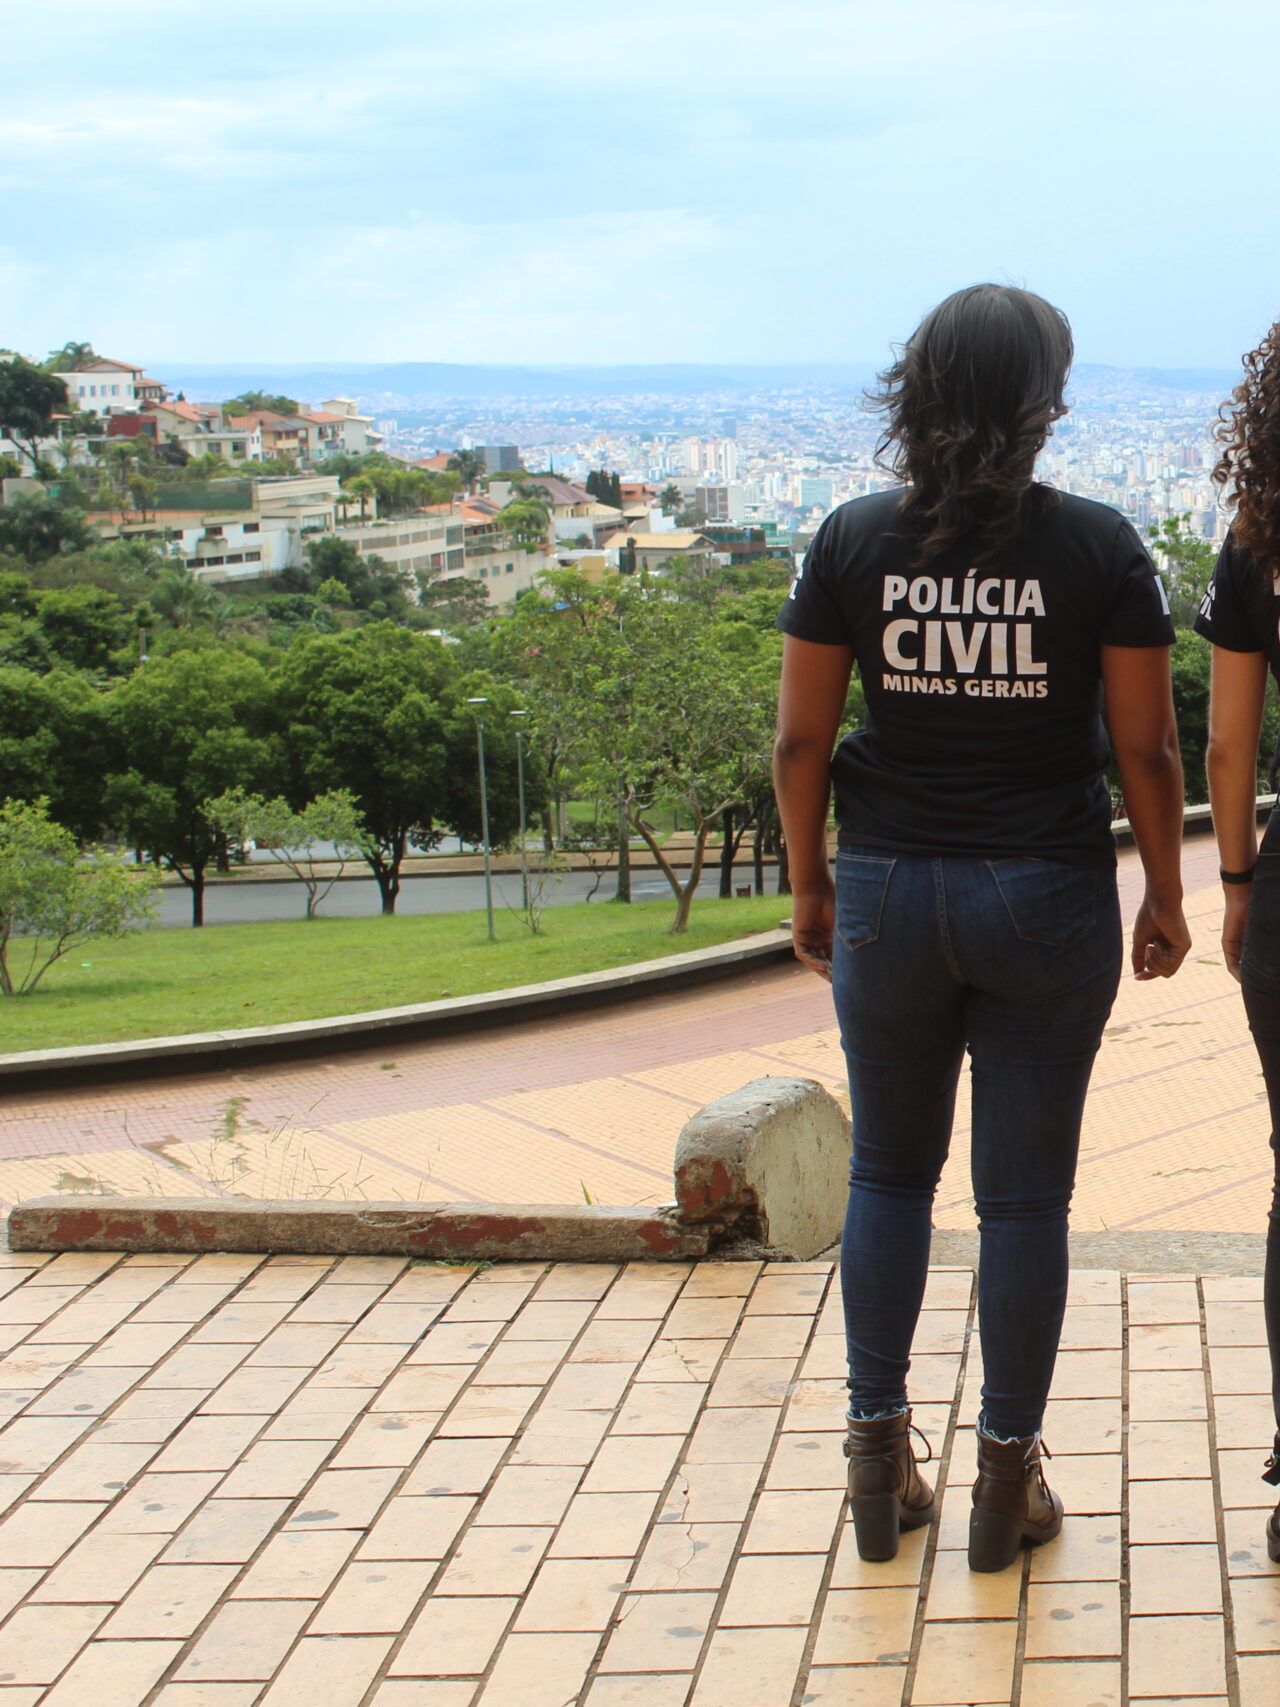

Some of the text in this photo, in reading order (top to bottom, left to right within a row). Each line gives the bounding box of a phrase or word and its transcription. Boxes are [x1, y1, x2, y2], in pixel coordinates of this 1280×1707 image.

[882, 568, 1046, 617] POLÍCIA
[882, 618, 1048, 675] CIVIL
[882, 673, 1048, 699] MINAS GERAIS
